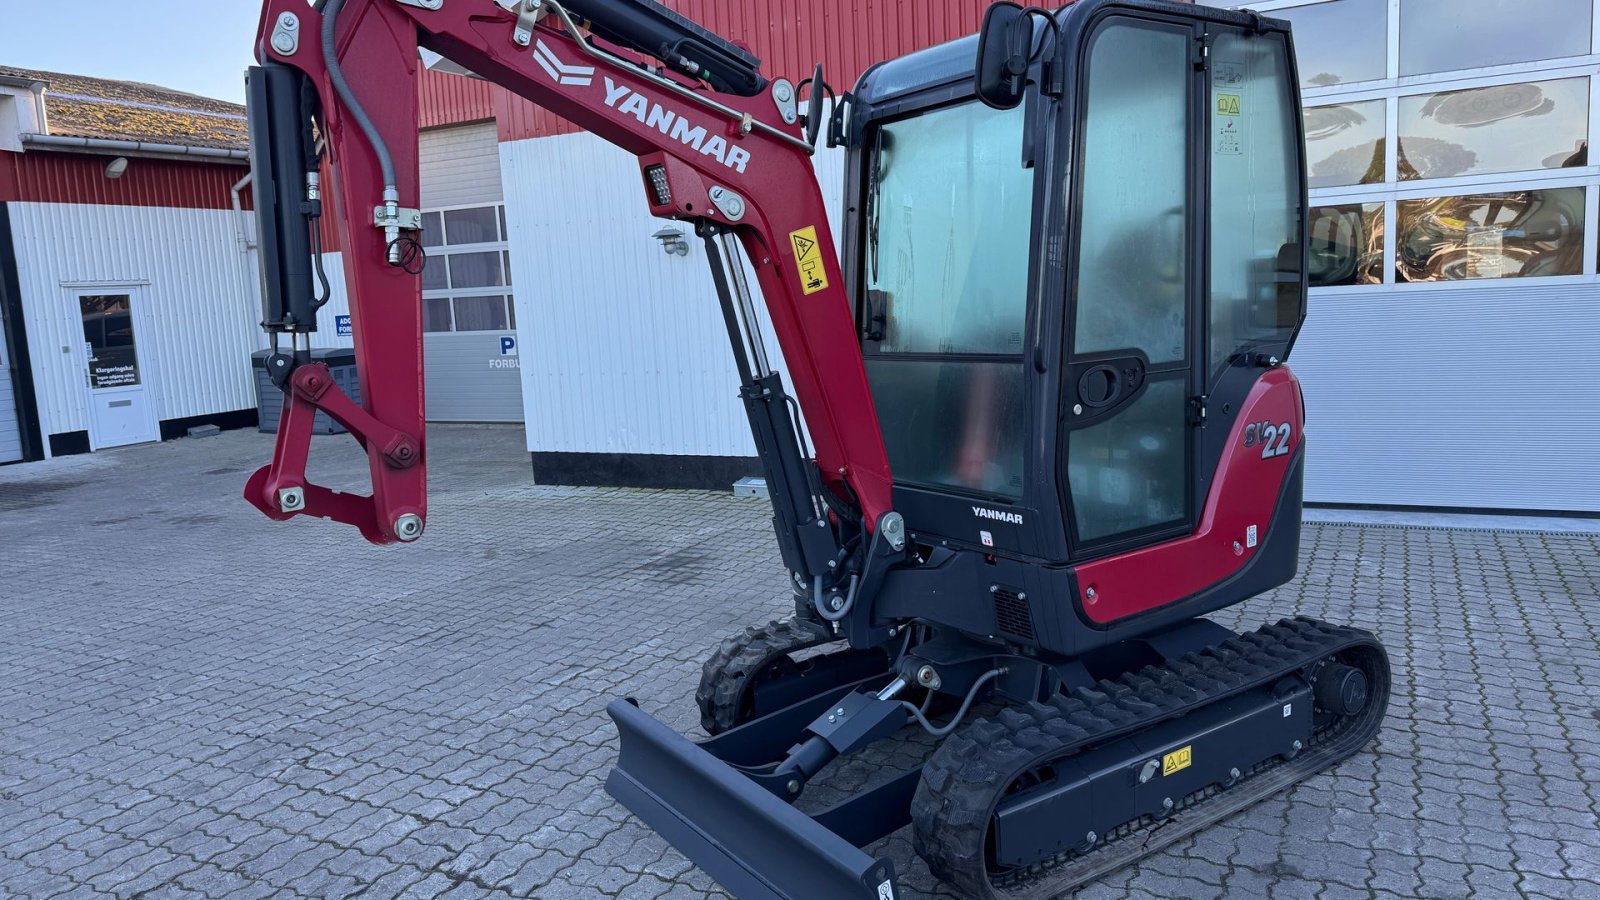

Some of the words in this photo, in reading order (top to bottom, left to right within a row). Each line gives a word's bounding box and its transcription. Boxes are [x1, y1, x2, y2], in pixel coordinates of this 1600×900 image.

[603, 76, 752, 174] YANMAR
[500, 337, 515, 355] P
[971, 506, 1024, 525] YANMAR
